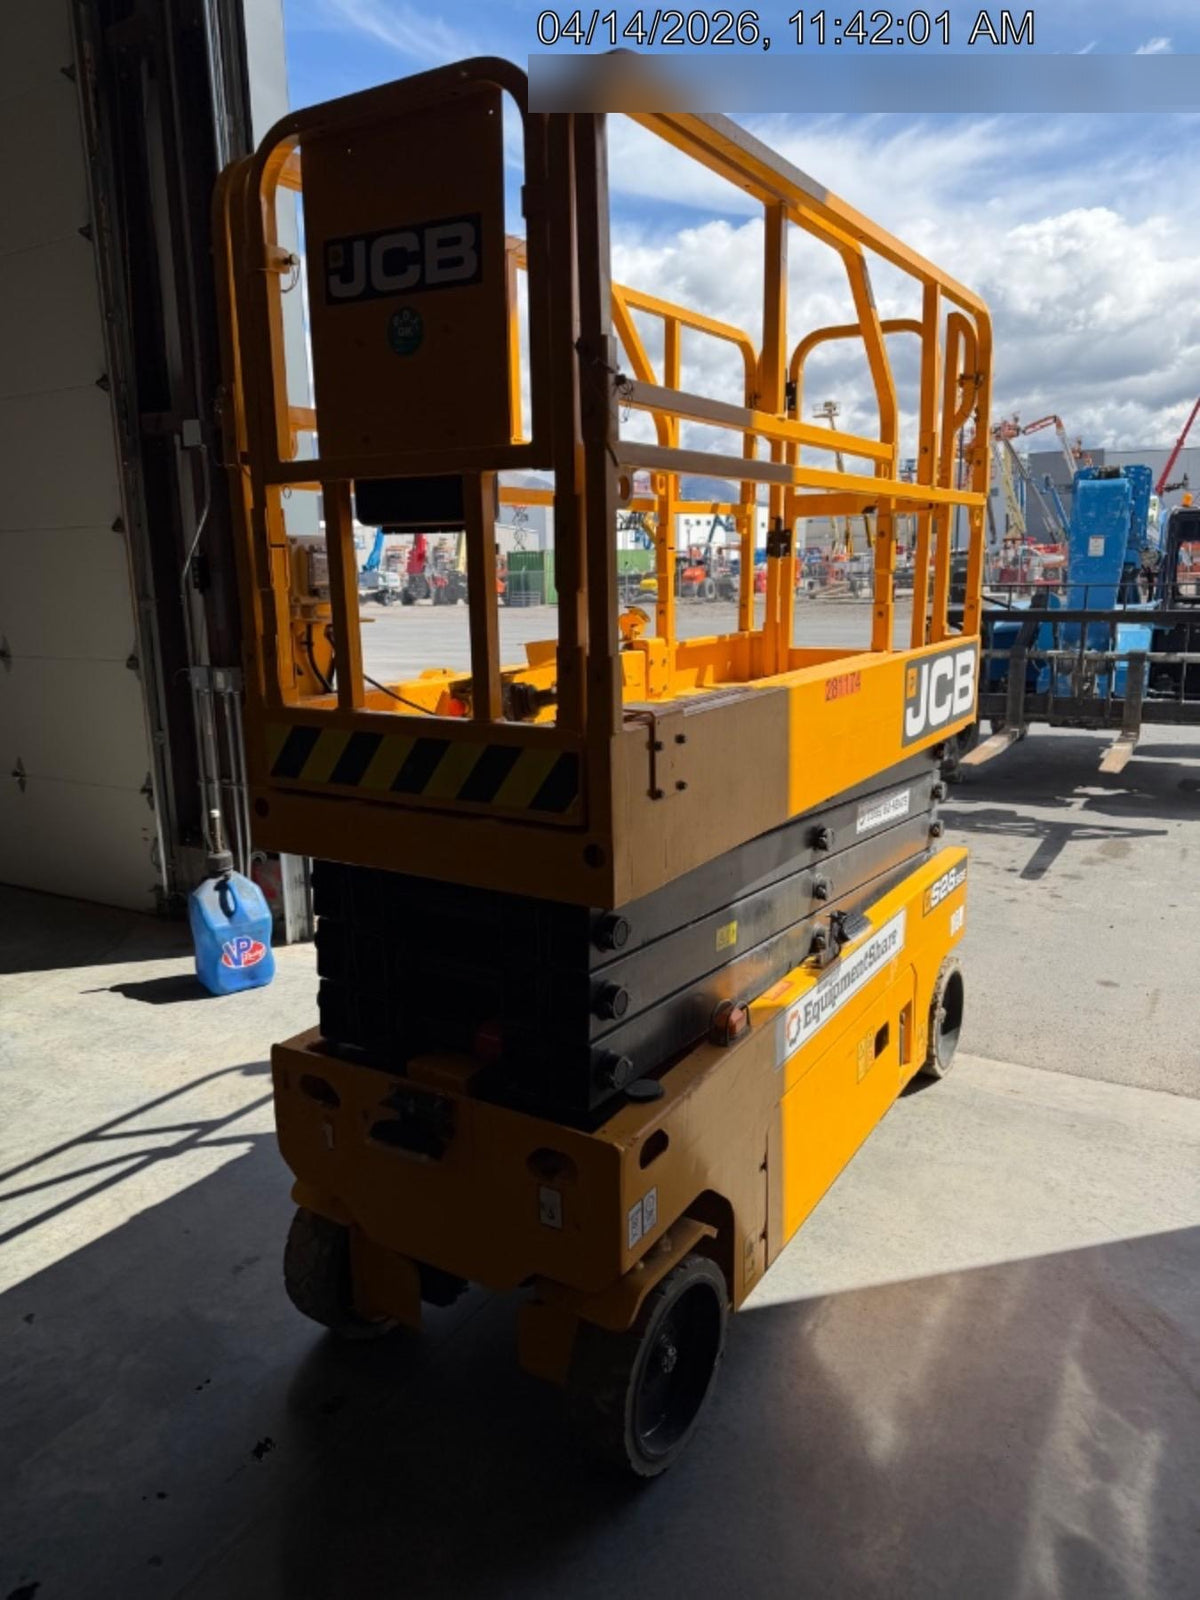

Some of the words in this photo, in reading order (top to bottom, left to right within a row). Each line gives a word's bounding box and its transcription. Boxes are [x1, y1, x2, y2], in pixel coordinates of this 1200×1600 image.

[328, 221, 478, 298] JCB
[905, 649, 975, 737] JCB
[222, 936, 252, 967] VP
[803, 929, 899, 1027] EquipmentShare
